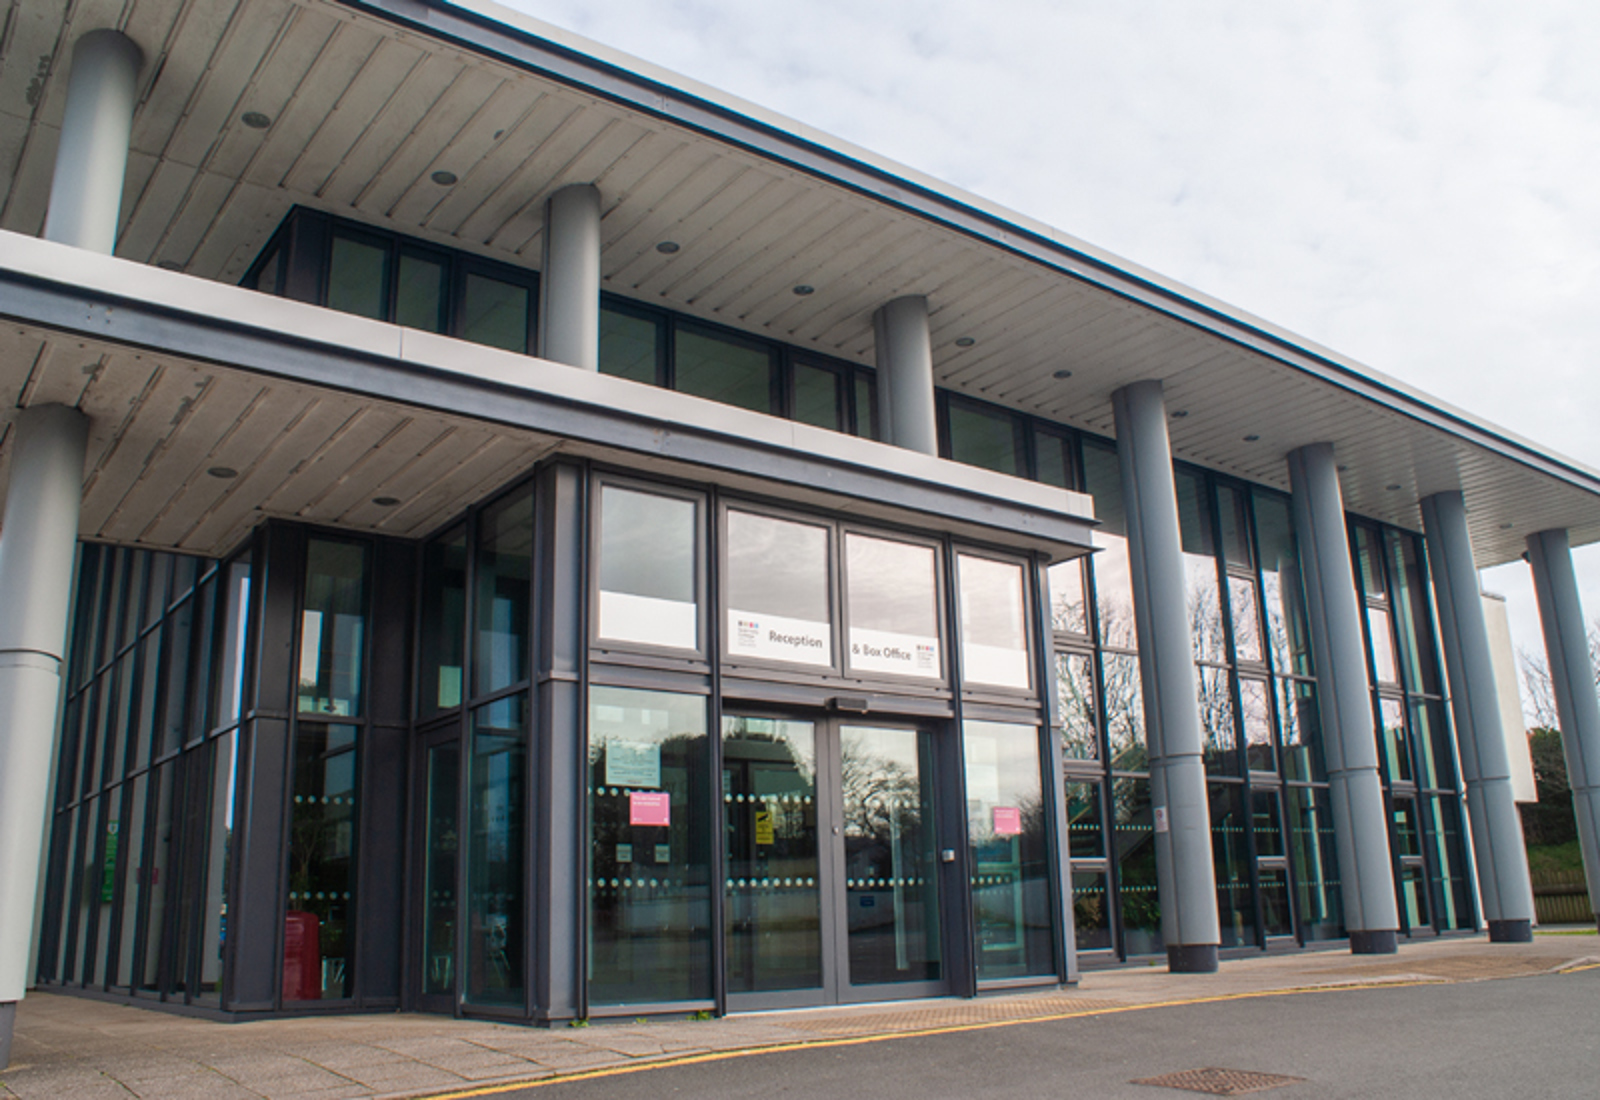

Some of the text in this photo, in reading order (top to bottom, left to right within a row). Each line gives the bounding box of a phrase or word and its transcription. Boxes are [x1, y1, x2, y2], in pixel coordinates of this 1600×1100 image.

[769, 630, 823, 648] Reception
[852, 643, 860, 654] &
[863, 643, 881, 657] Box
[883, 647, 911, 660] Office
